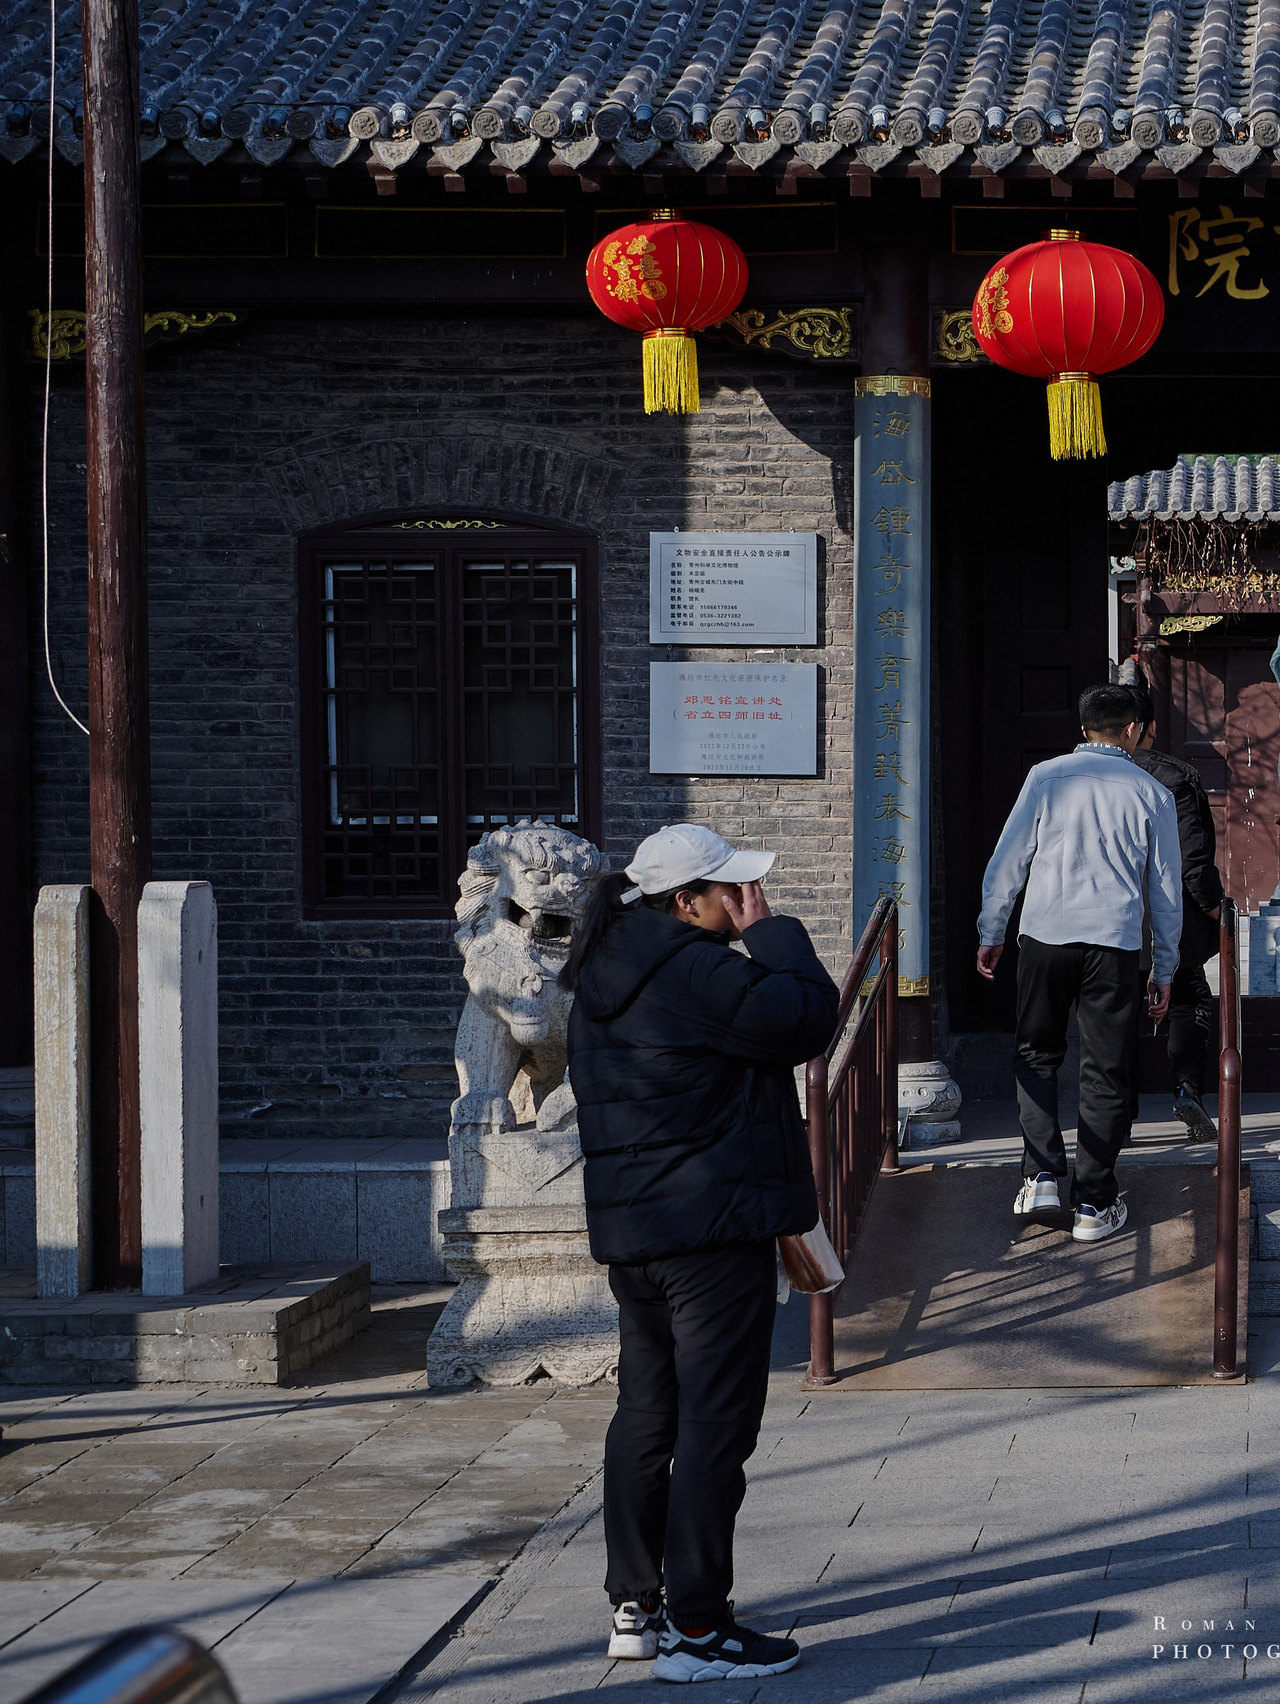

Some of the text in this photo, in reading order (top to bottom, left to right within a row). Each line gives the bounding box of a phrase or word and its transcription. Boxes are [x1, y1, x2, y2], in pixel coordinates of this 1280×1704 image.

[676, 548, 791, 558] 文物安全直接责任人公告公示牌
[684, 695, 783, 706] 邓恩铭宣讲处
